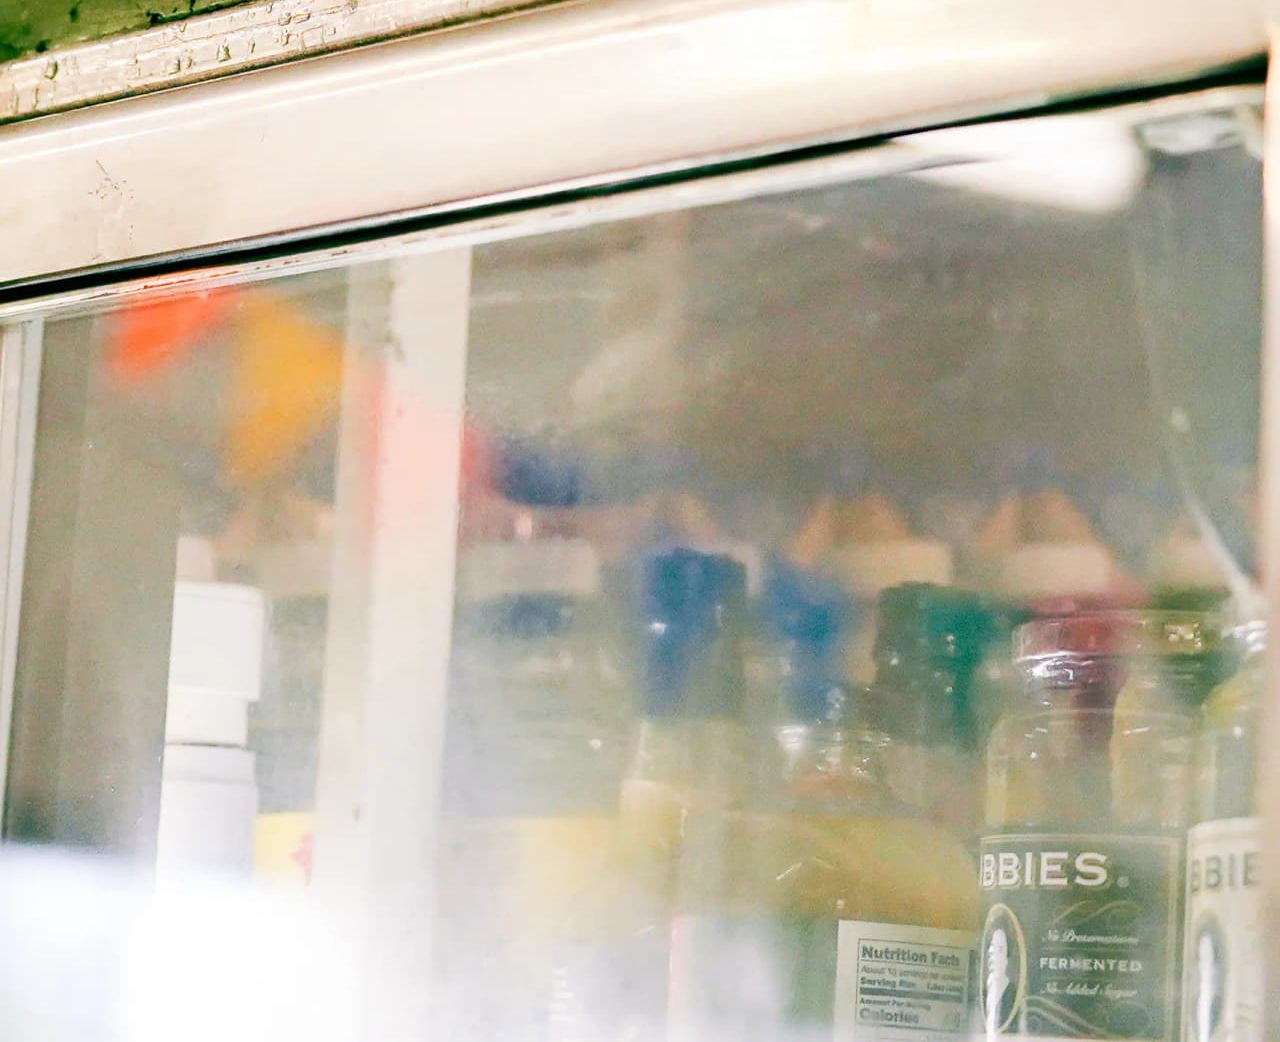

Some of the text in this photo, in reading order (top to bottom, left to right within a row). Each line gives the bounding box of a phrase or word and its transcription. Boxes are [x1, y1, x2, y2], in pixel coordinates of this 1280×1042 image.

[862, 945, 960, 967] Nutrition Facts
[1039, 957, 1142, 973] FERMENTED
[859, 1007, 920, 1024] Calories
